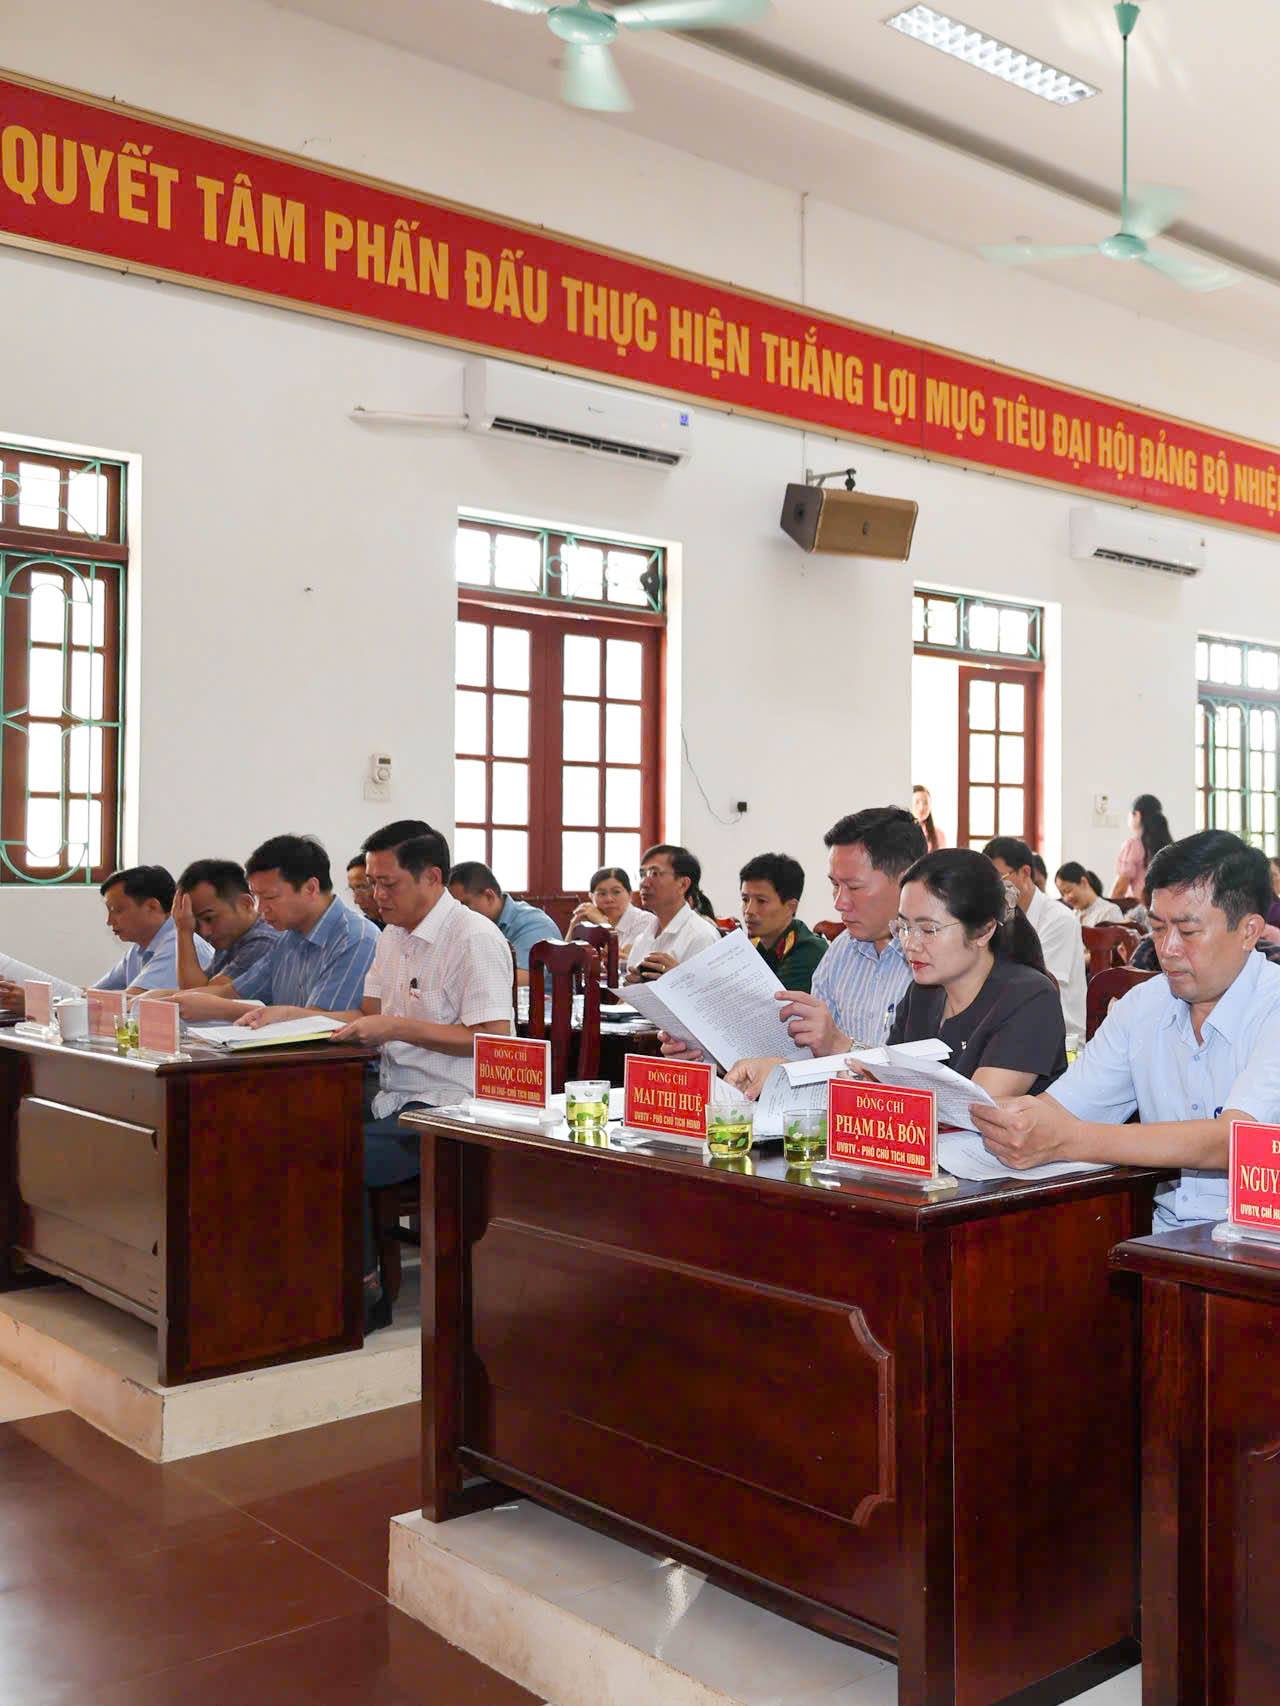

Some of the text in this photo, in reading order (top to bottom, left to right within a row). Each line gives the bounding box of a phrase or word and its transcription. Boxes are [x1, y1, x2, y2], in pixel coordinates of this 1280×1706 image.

[1, 125, 180, 231] QUYẾT
[196, 173, 306, 264] TÂM
[324, 219, 450, 300] PHẤN
[464, 249, 549, 325] ĐẤU
[561, 276, 657, 356] THỰC
[669, 307, 751, 380] HIỆN
[761, 326, 864, 405] THẮNG
[873, 363, 917, 425] LỢI
[926, 377, 986, 440] MỤC
[992, 394, 1046, 451] TIÊU
[1052, 413, 1092, 469] ĐẠI
[1098, 421, 1136, 480] HỘI
[1140, 429, 1198, 491] ĐẢNG
[1202, 450, 1230, 505] BỘ
[633, 1087, 703, 1116] MAI THỊ HUỆ
[886, 1099, 904, 1114] CHÍ
[835, 1114, 874, 1140] PHẠM
[877, 1116, 895, 1140] BÁ
